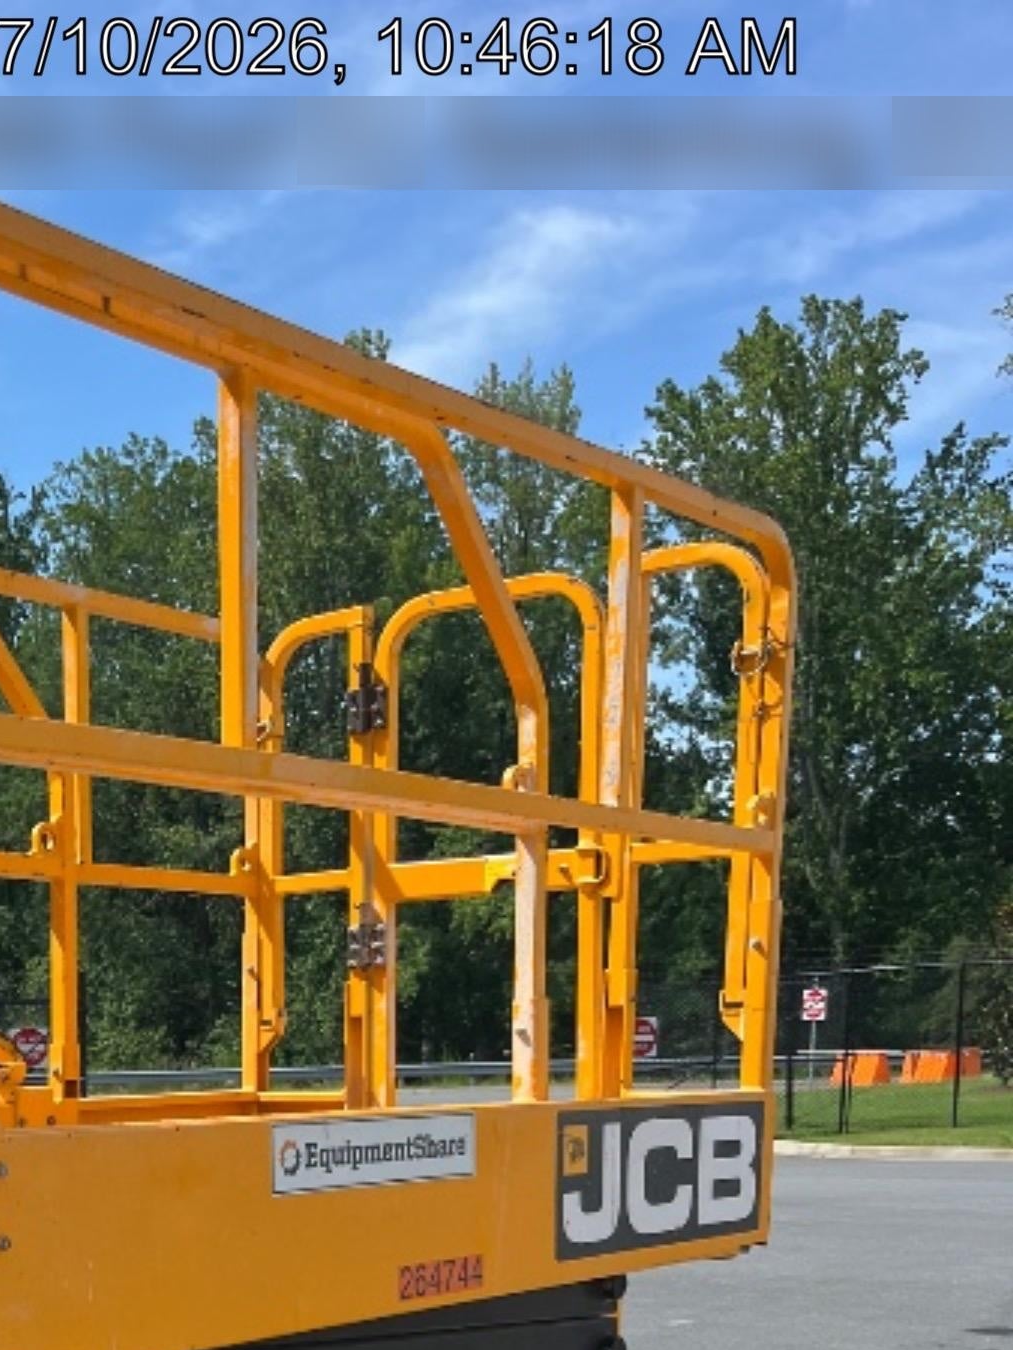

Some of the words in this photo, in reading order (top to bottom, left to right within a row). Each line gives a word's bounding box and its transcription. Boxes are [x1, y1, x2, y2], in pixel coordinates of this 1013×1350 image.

[304, 1133, 467, 1174] EquipmentShare
[562, 1115, 757, 1243] JCB
[400, 1255, 483, 1300] 264744
